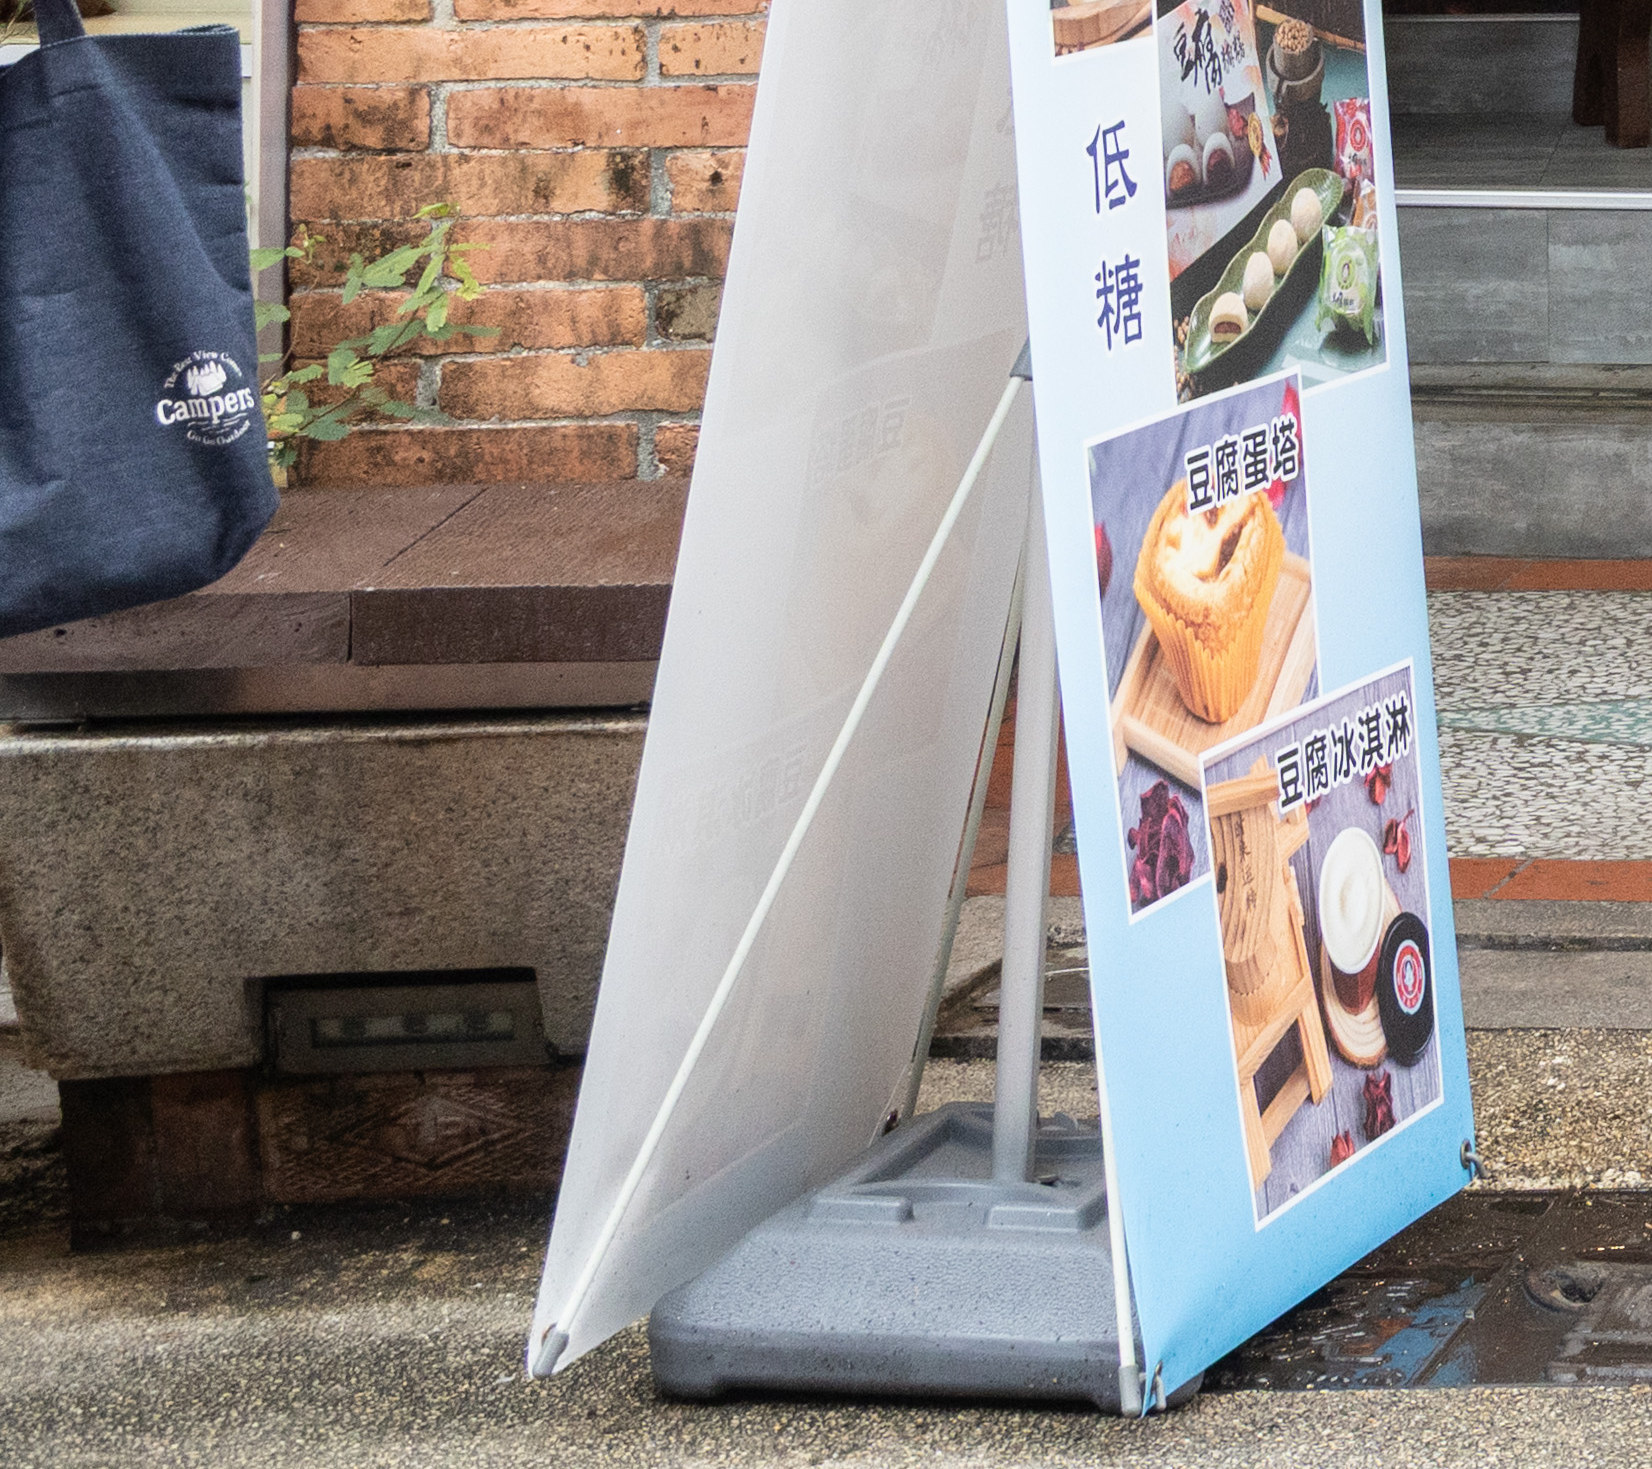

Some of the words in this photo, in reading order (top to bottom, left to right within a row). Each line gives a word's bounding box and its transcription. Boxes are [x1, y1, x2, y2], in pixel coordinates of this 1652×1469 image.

[1086, 120, 1144, 351] 低糖
[157, 386, 256, 425] Campers
[1187, 419, 1299, 512] 豆腐蛋塔
[1278, 705, 1411, 809] 豆腐冰淇淋
